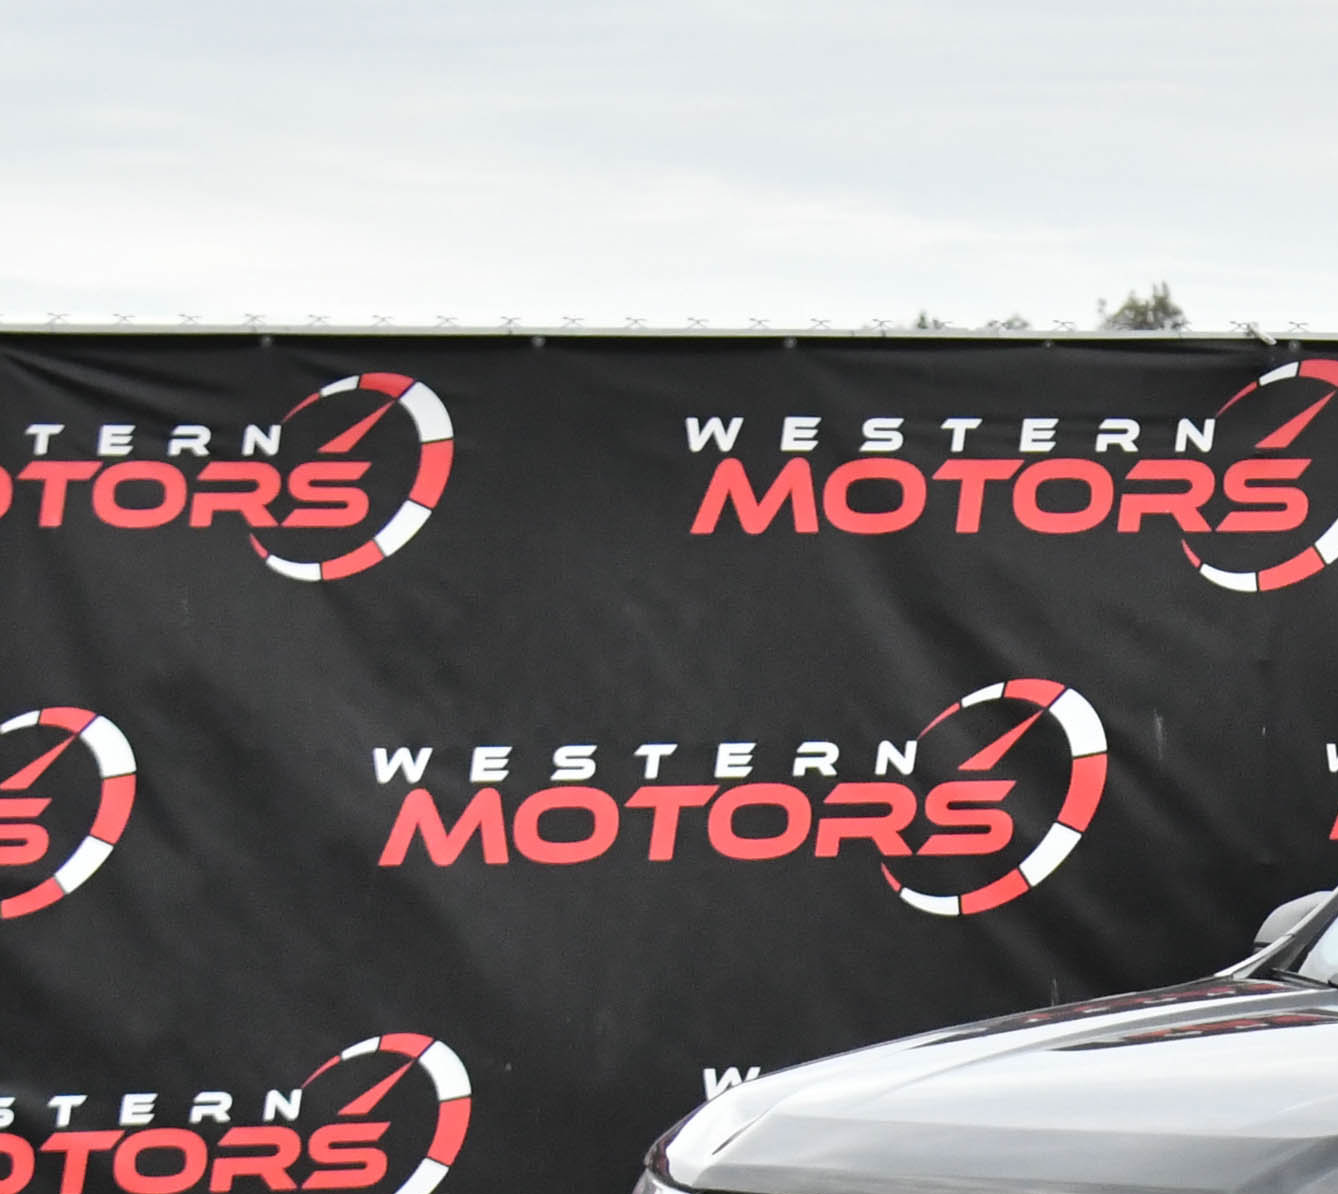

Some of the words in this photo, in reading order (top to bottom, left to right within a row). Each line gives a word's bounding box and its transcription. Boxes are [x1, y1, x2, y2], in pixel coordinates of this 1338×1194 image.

[685, 416, 1216, 453] WESTERN
[0, 460, 372, 529] TORS
[690, 457, 1312, 535] MOTORS
[372, 740, 918, 784] WESTERN
[378, 780, 1016, 868] MOTORS
